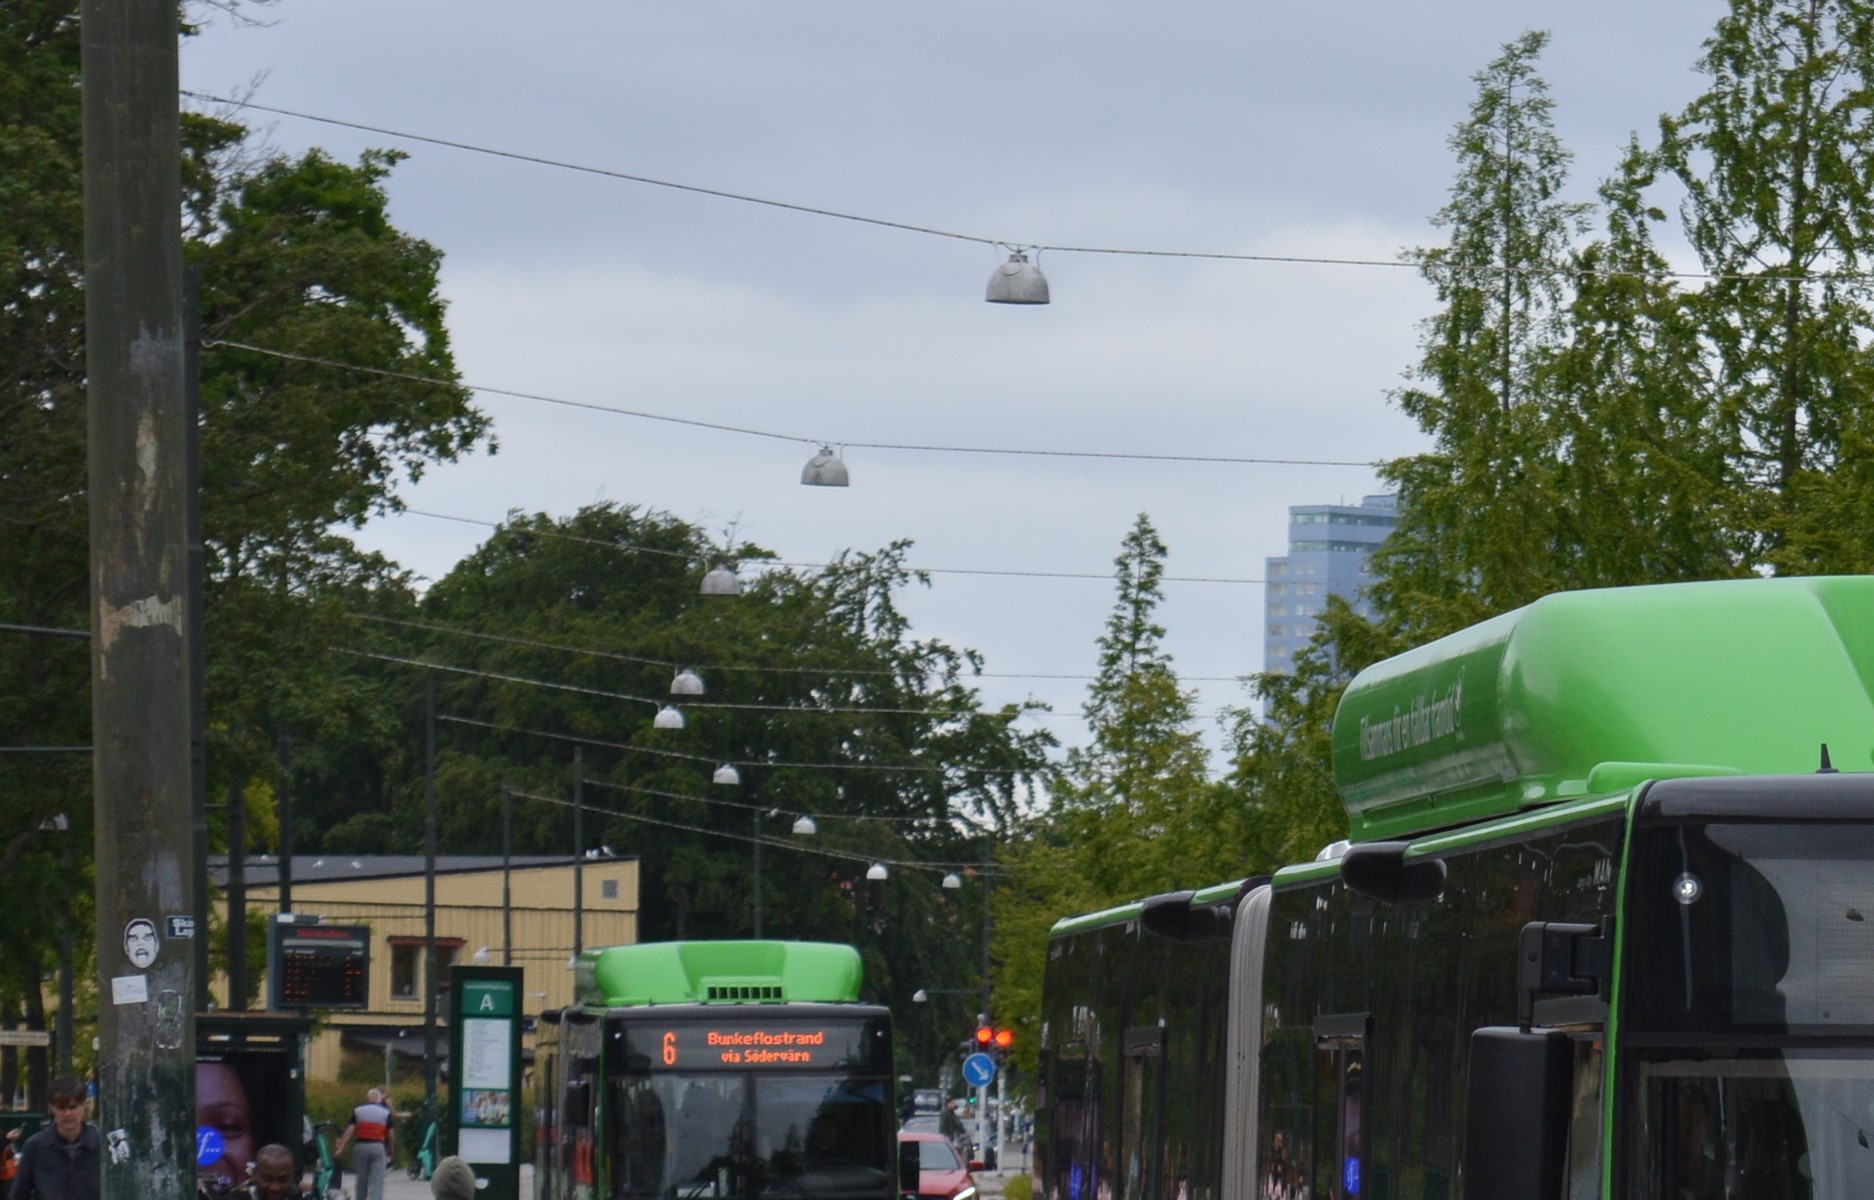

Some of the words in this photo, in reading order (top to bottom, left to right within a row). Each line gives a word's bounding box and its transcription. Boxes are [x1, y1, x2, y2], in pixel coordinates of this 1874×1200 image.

[1593, 857, 1612, 886] MAN
[479, 993, 495, 1011] A
[662, 1032, 677, 1065] 6
[707, 1031, 824, 1046] Bunkeflostrand
[720, 1049, 740, 1063] via
[744, 1049, 810, 1063] Södervärn
